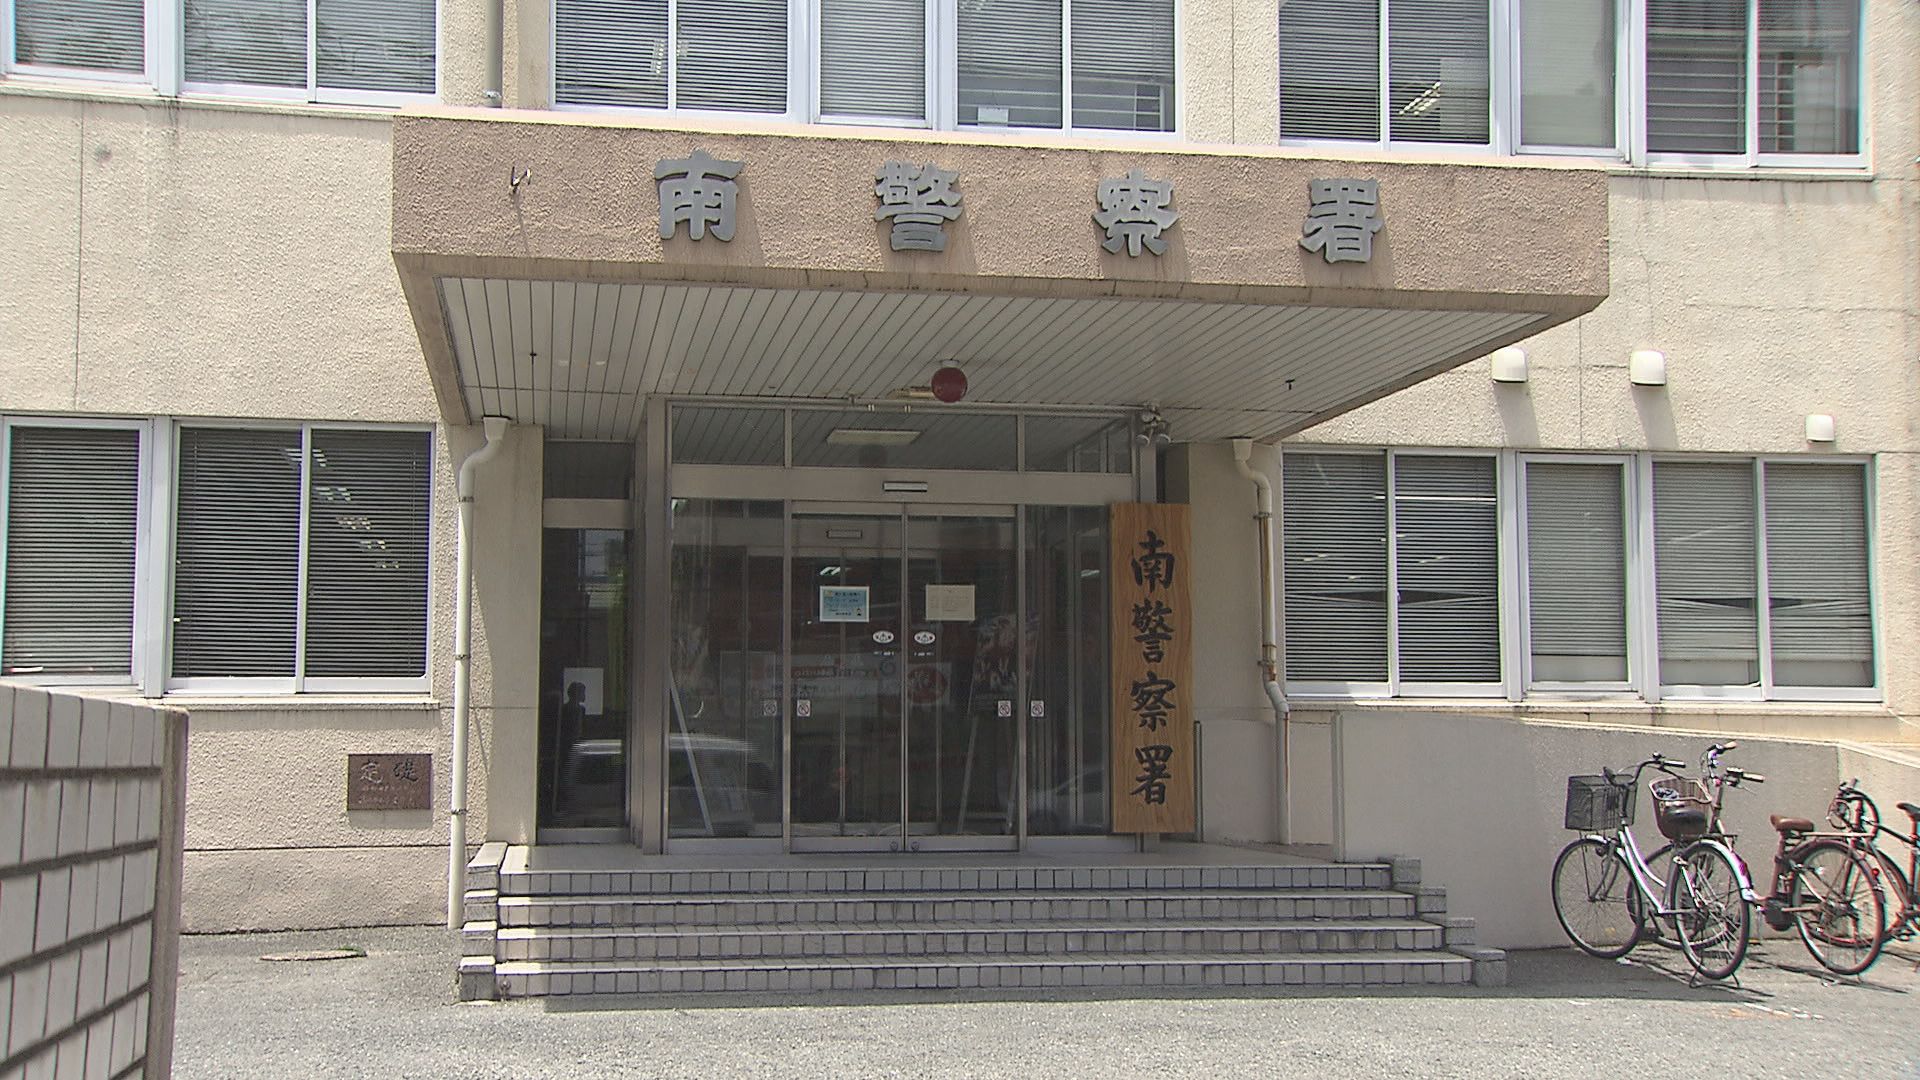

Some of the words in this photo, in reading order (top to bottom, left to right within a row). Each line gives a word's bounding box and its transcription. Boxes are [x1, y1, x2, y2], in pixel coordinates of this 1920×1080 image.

[653, 148, 1382, 264] 南警察署
[1130, 530, 1176, 805] 南警察署
